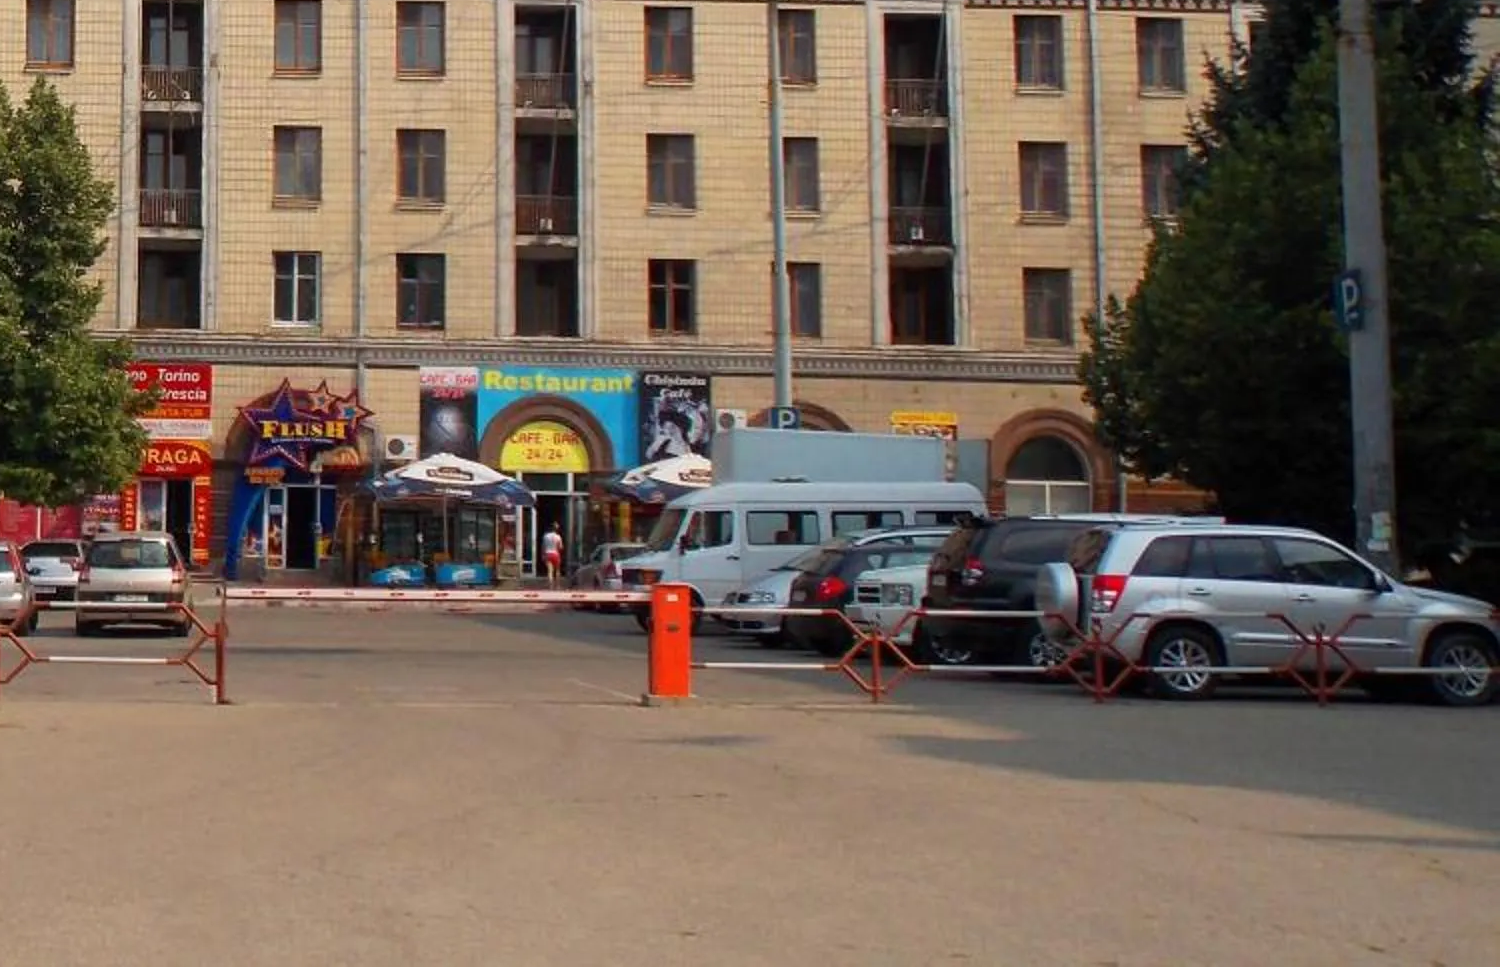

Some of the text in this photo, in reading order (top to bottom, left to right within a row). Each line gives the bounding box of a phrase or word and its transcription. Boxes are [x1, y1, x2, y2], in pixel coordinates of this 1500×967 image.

[157, 368, 201, 382] Torino
[483, 369, 634, 393] Restaurant
[778, 409, 796, 429] P
[259, 420, 349, 439] FLUSH
